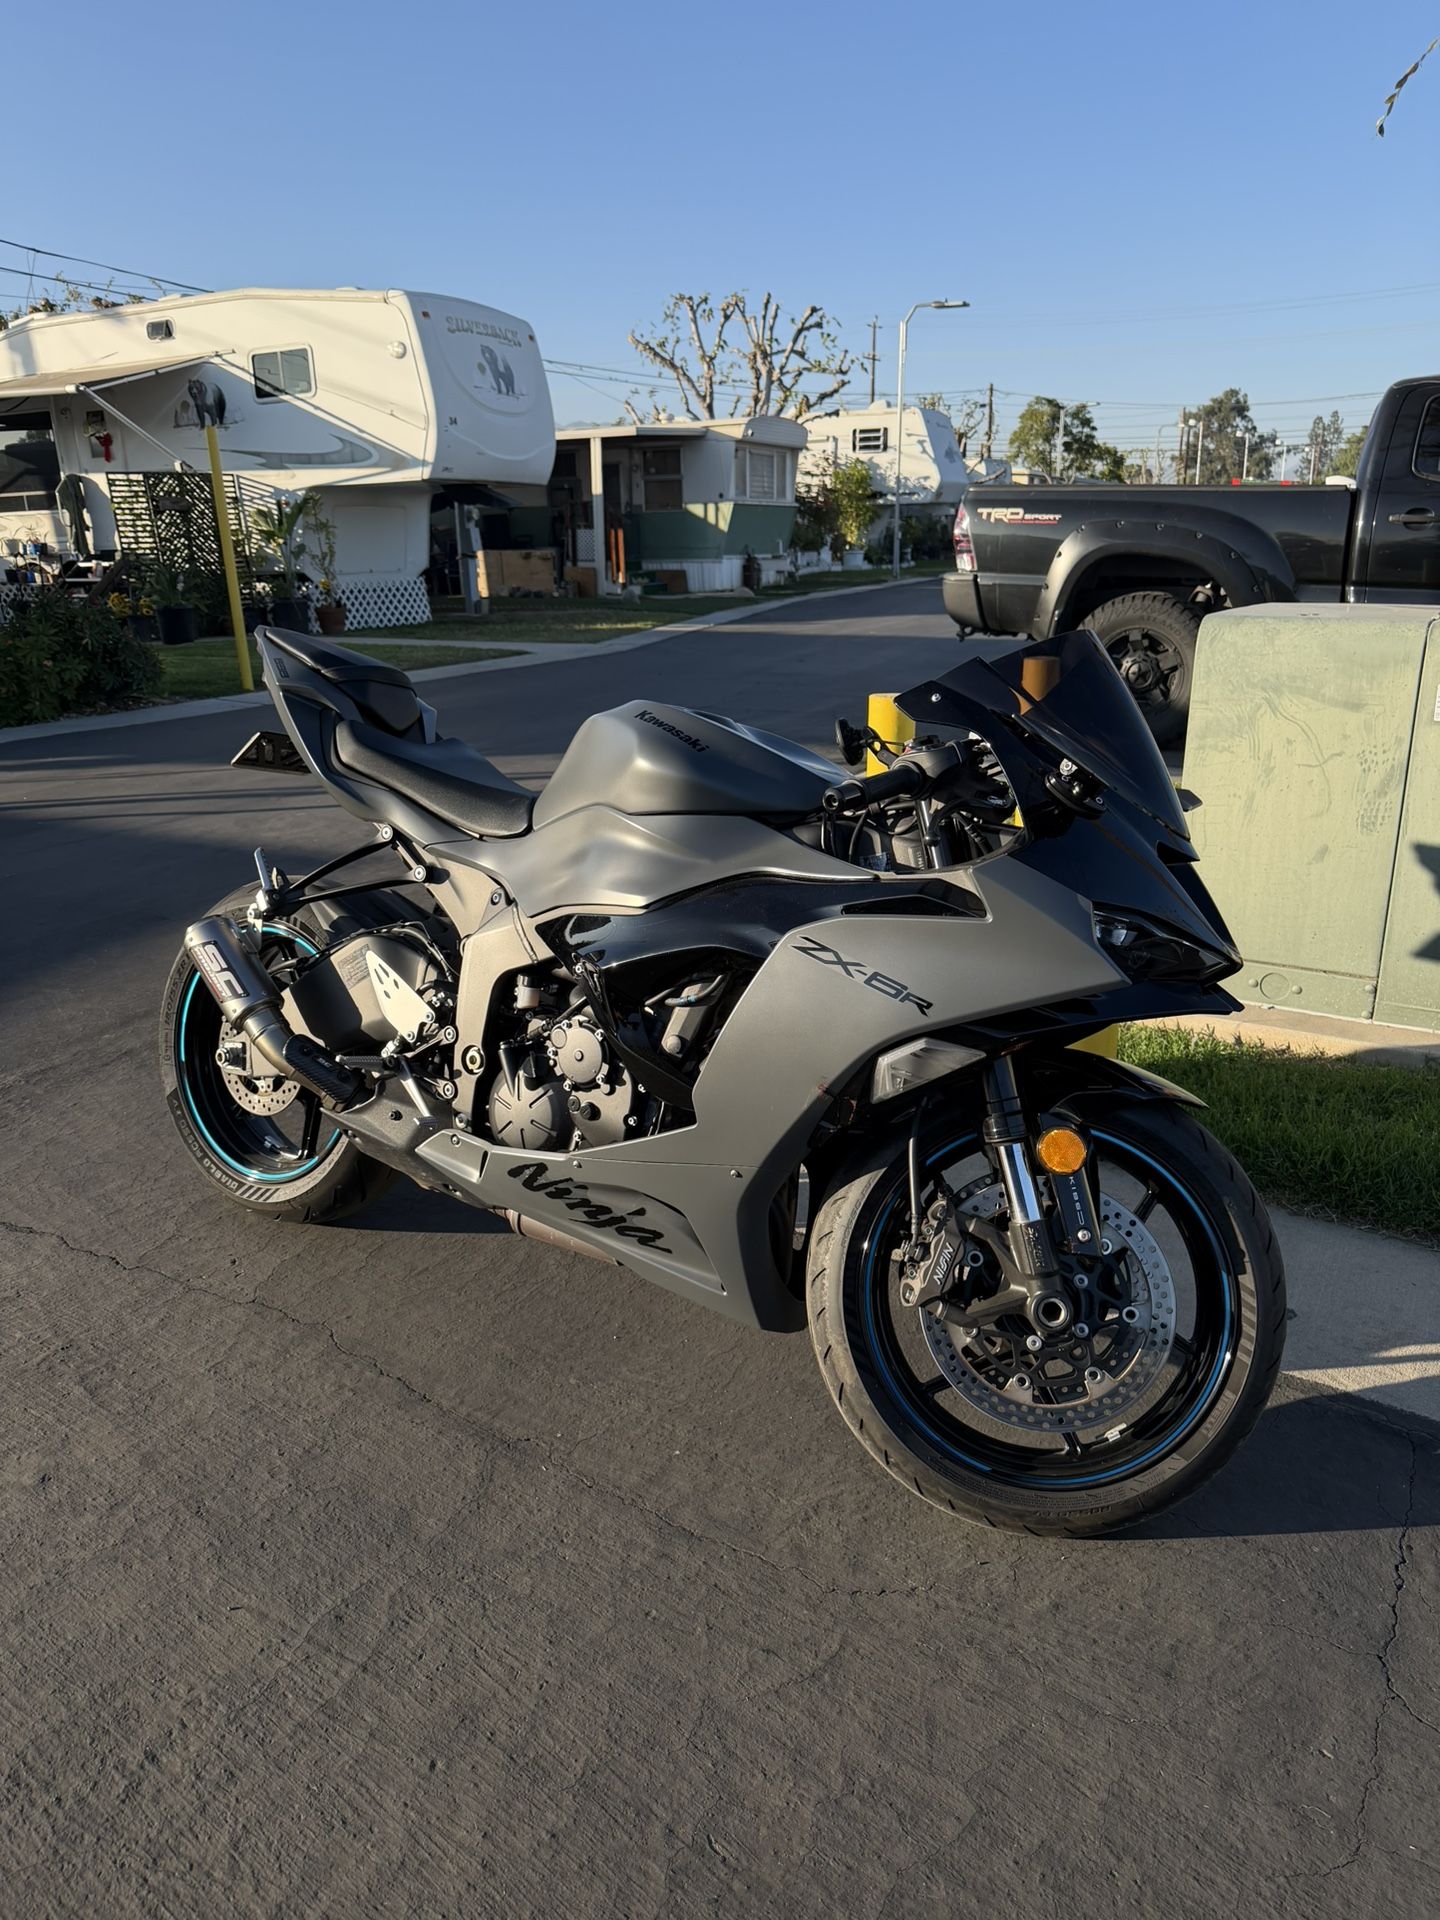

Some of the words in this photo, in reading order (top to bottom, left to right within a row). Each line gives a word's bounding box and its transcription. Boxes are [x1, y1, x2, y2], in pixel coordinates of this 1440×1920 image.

[446, 316, 522, 347] SILVERBACK
[977, 507, 1024, 523] TRD
[1024, 513, 1062, 521] SPORT
[634, 709, 711, 753] Kawasaki
[199, 943, 245, 998] SC
[791, 935, 934, 1017] ZX-6R
[180, 1119, 203, 1158] ROSSO
[202, 1158, 239, 1190] DIABLO
[507, 1162, 673, 1254] Ninja
